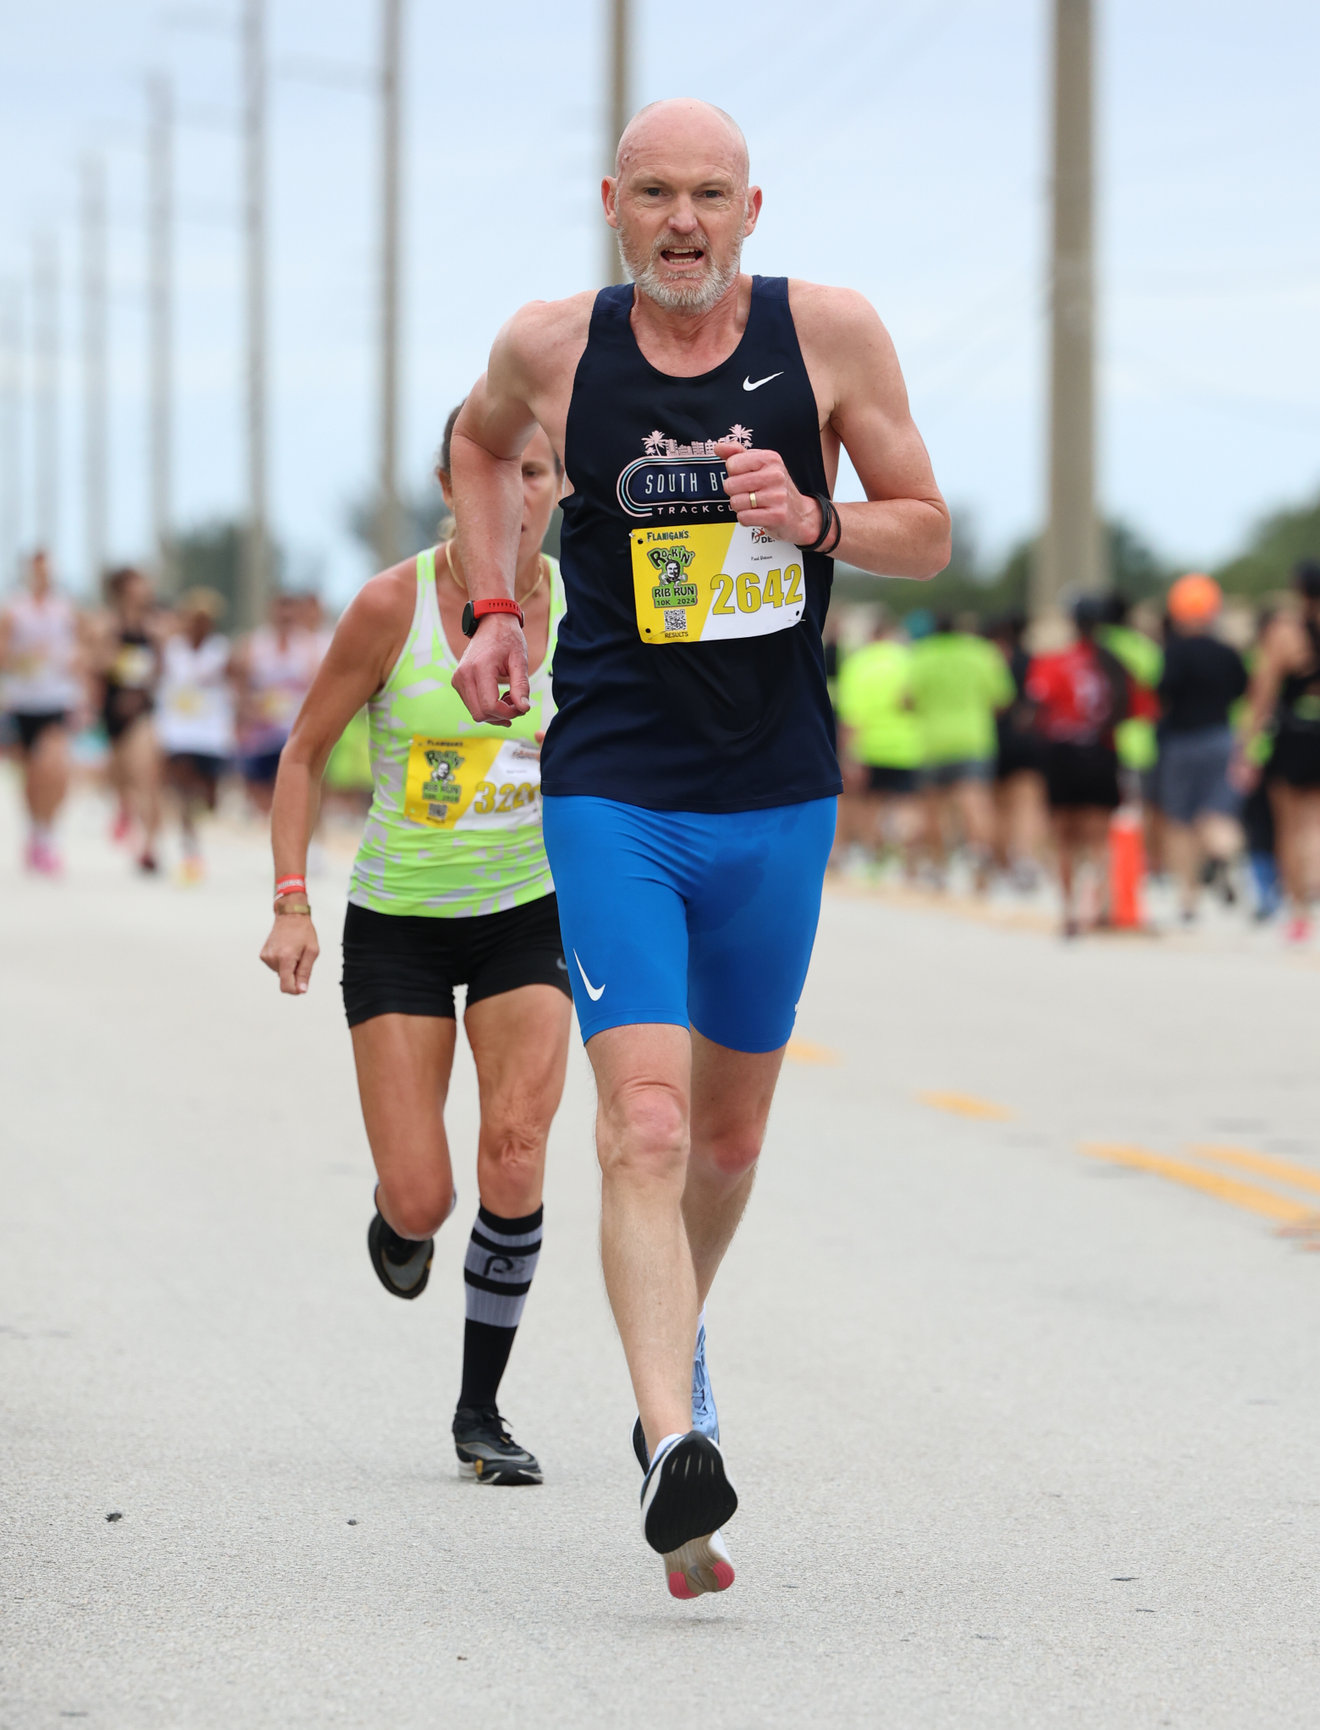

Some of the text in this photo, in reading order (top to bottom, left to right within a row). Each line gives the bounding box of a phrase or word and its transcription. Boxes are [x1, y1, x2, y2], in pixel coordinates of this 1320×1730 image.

[645, 471, 728, 494] SOUTH BE
[657, 504, 735, 515] TRACK CL
[646, 530, 689, 541] FLANIGAN'S
[654, 586, 695, 598] RIB RUN
[710, 563, 803, 615] 2642
[677, 597, 696, 605] 2024
